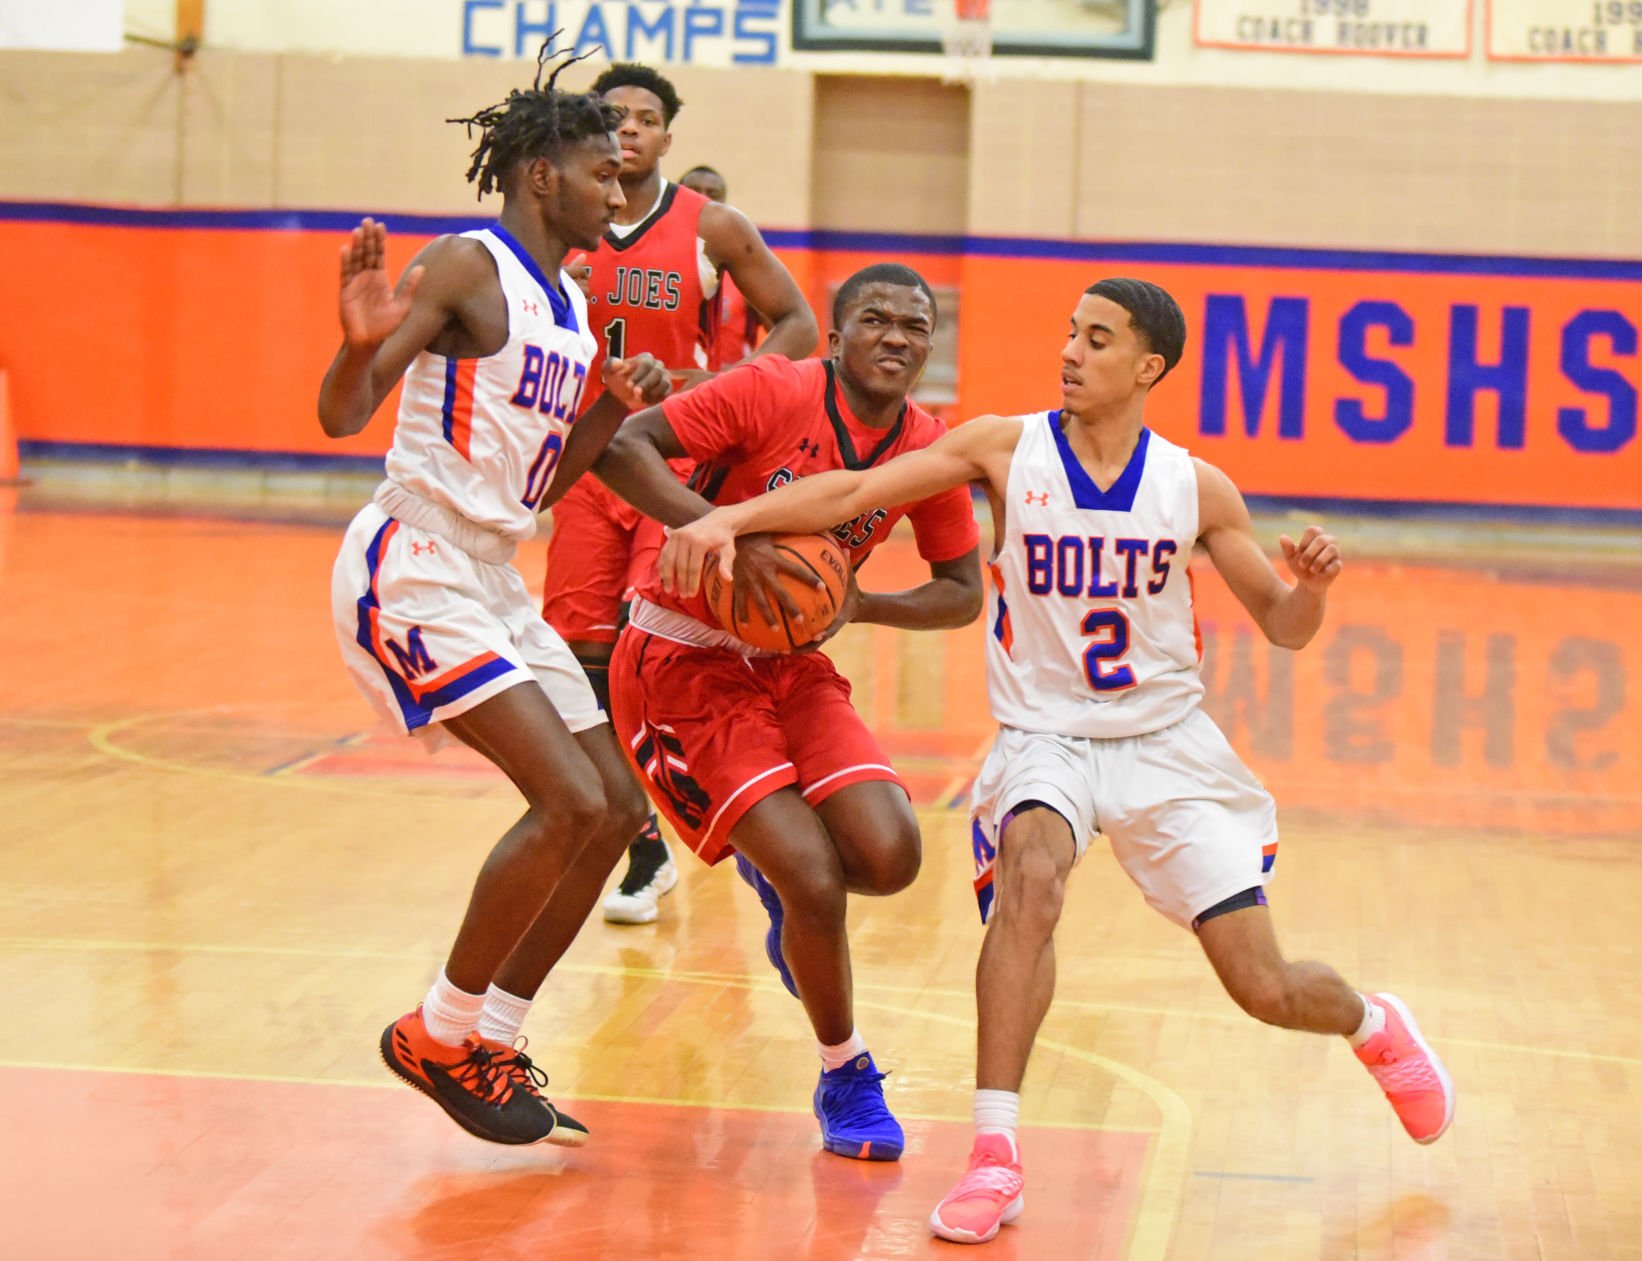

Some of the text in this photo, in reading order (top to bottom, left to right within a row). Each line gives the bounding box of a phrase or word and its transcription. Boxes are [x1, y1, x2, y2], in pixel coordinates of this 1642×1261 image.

[462, 1, 778, 63] CHAMPS
[1237, 16, 1312, 42] COACH
[1528, 27, 1606, 54] COACH
[1592, 1, 1642, 25] 199
[607, 266, 682, 312] JOES
[1199, 293, 1638, 455] MSHS
[521, 430, 564, 510] 0
[1023, 533, 1177, 599] BOLTS
[384, 624, 439, 680] M
[1080, 606, 1138, 692] 2
